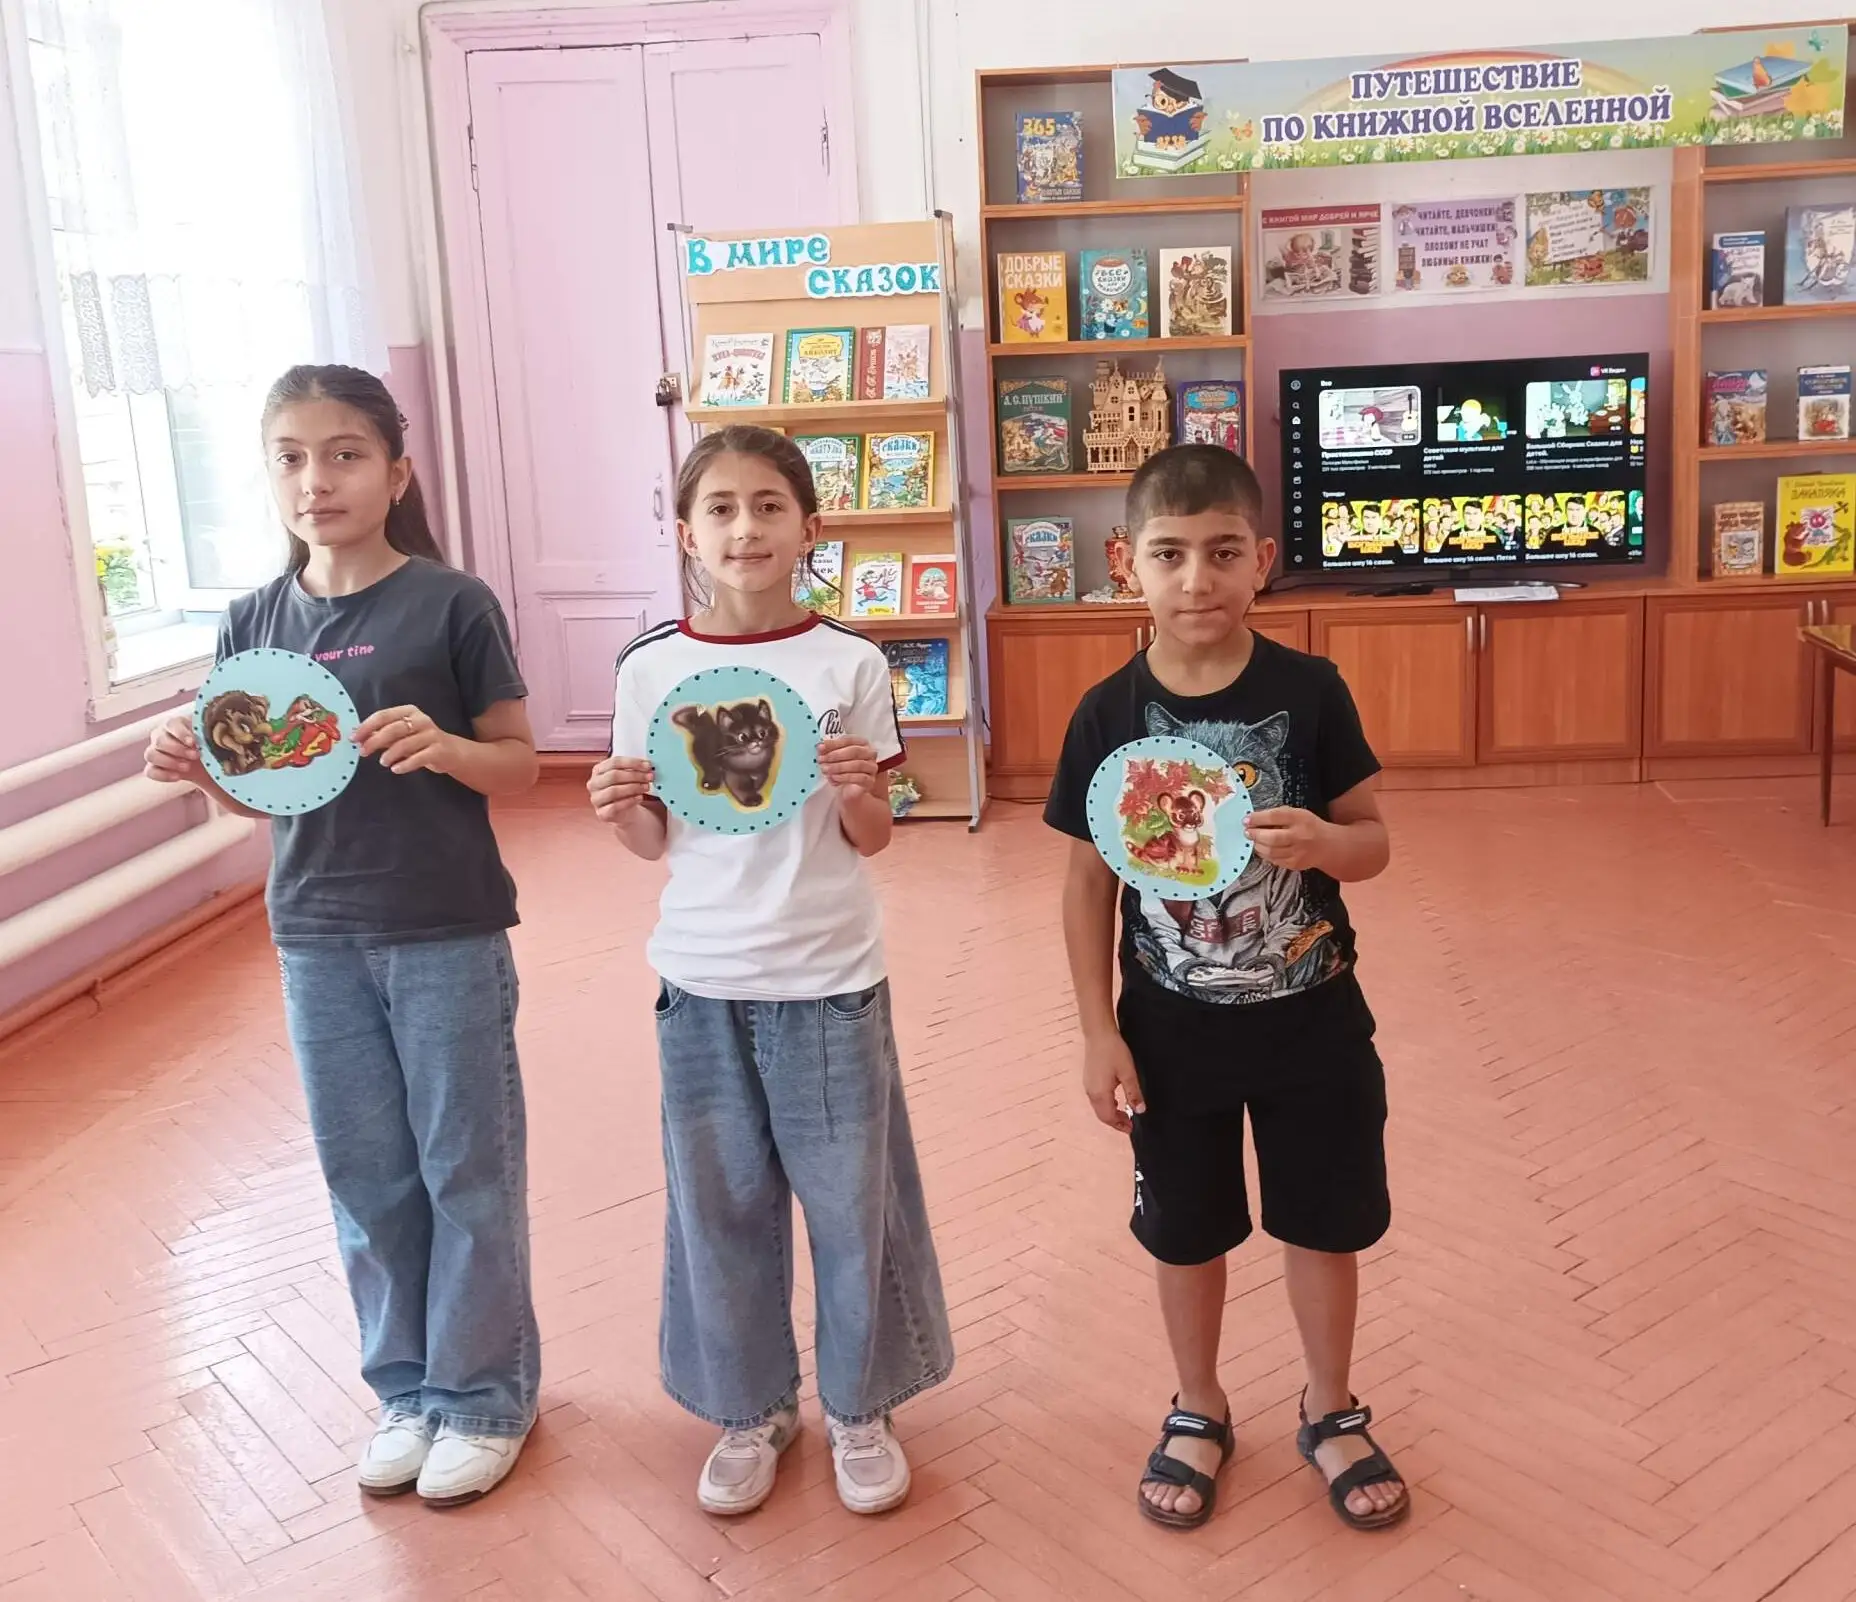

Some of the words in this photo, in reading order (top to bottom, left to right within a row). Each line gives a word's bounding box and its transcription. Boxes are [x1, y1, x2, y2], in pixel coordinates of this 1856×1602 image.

[1351, 60, 1581, 99] ПУТЕШЕСТВИЕ
[1262, 115, 1305, 143] ПО
[1313, 99, 1476, 140] КНИЖНОЙ
[1484, 86, 1672, 131] ВСЕЛЕННОЙ
[1023, 117, 1056, 136] 365
[1424, 240, 1458, 251] ПЛОХОМУ
[1460, 240, 1469, 249] НЕ
[1471, 239, 1489, 249] УЧАТ
[687, 238, 714, 274] В
[1005, 255, 1062, 274] ДОБРЫЕ
[808, 264, 940, 296] СКАЗОК
[1004, 272, 1063, 289] СКАЗКИ
[314, 649, 344, 662] your
